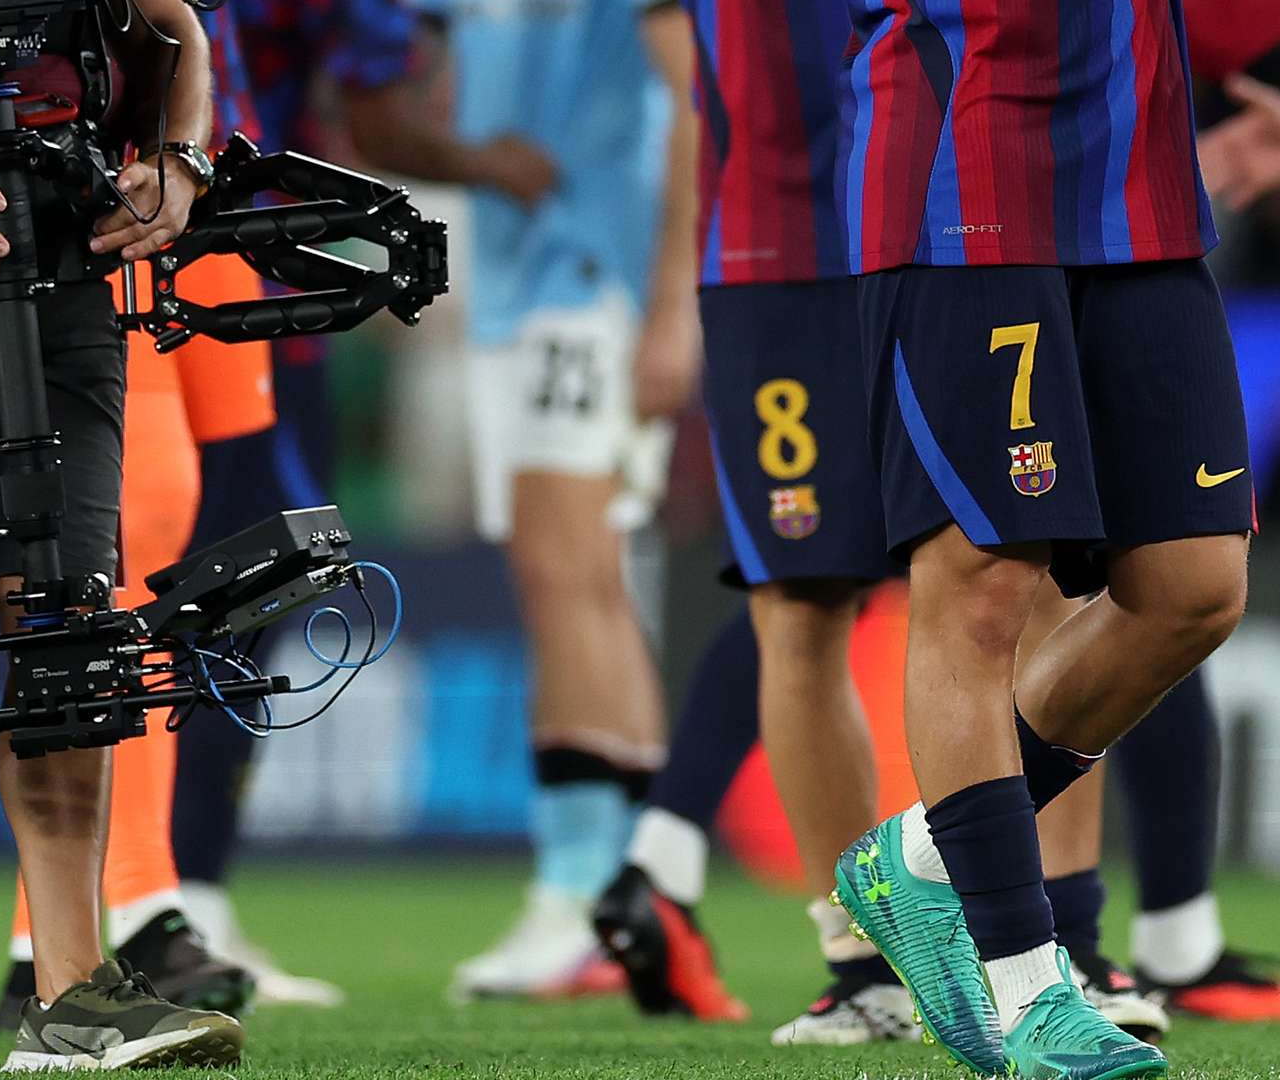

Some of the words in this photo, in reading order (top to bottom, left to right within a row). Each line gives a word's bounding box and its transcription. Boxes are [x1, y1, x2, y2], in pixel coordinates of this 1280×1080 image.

[942, 224, 1004, 235] AERO-FIT
[990, 322, 1040, 430] 7
[754, 378, 818, 480] 8
[86, 660, 111, 672] ARRI
